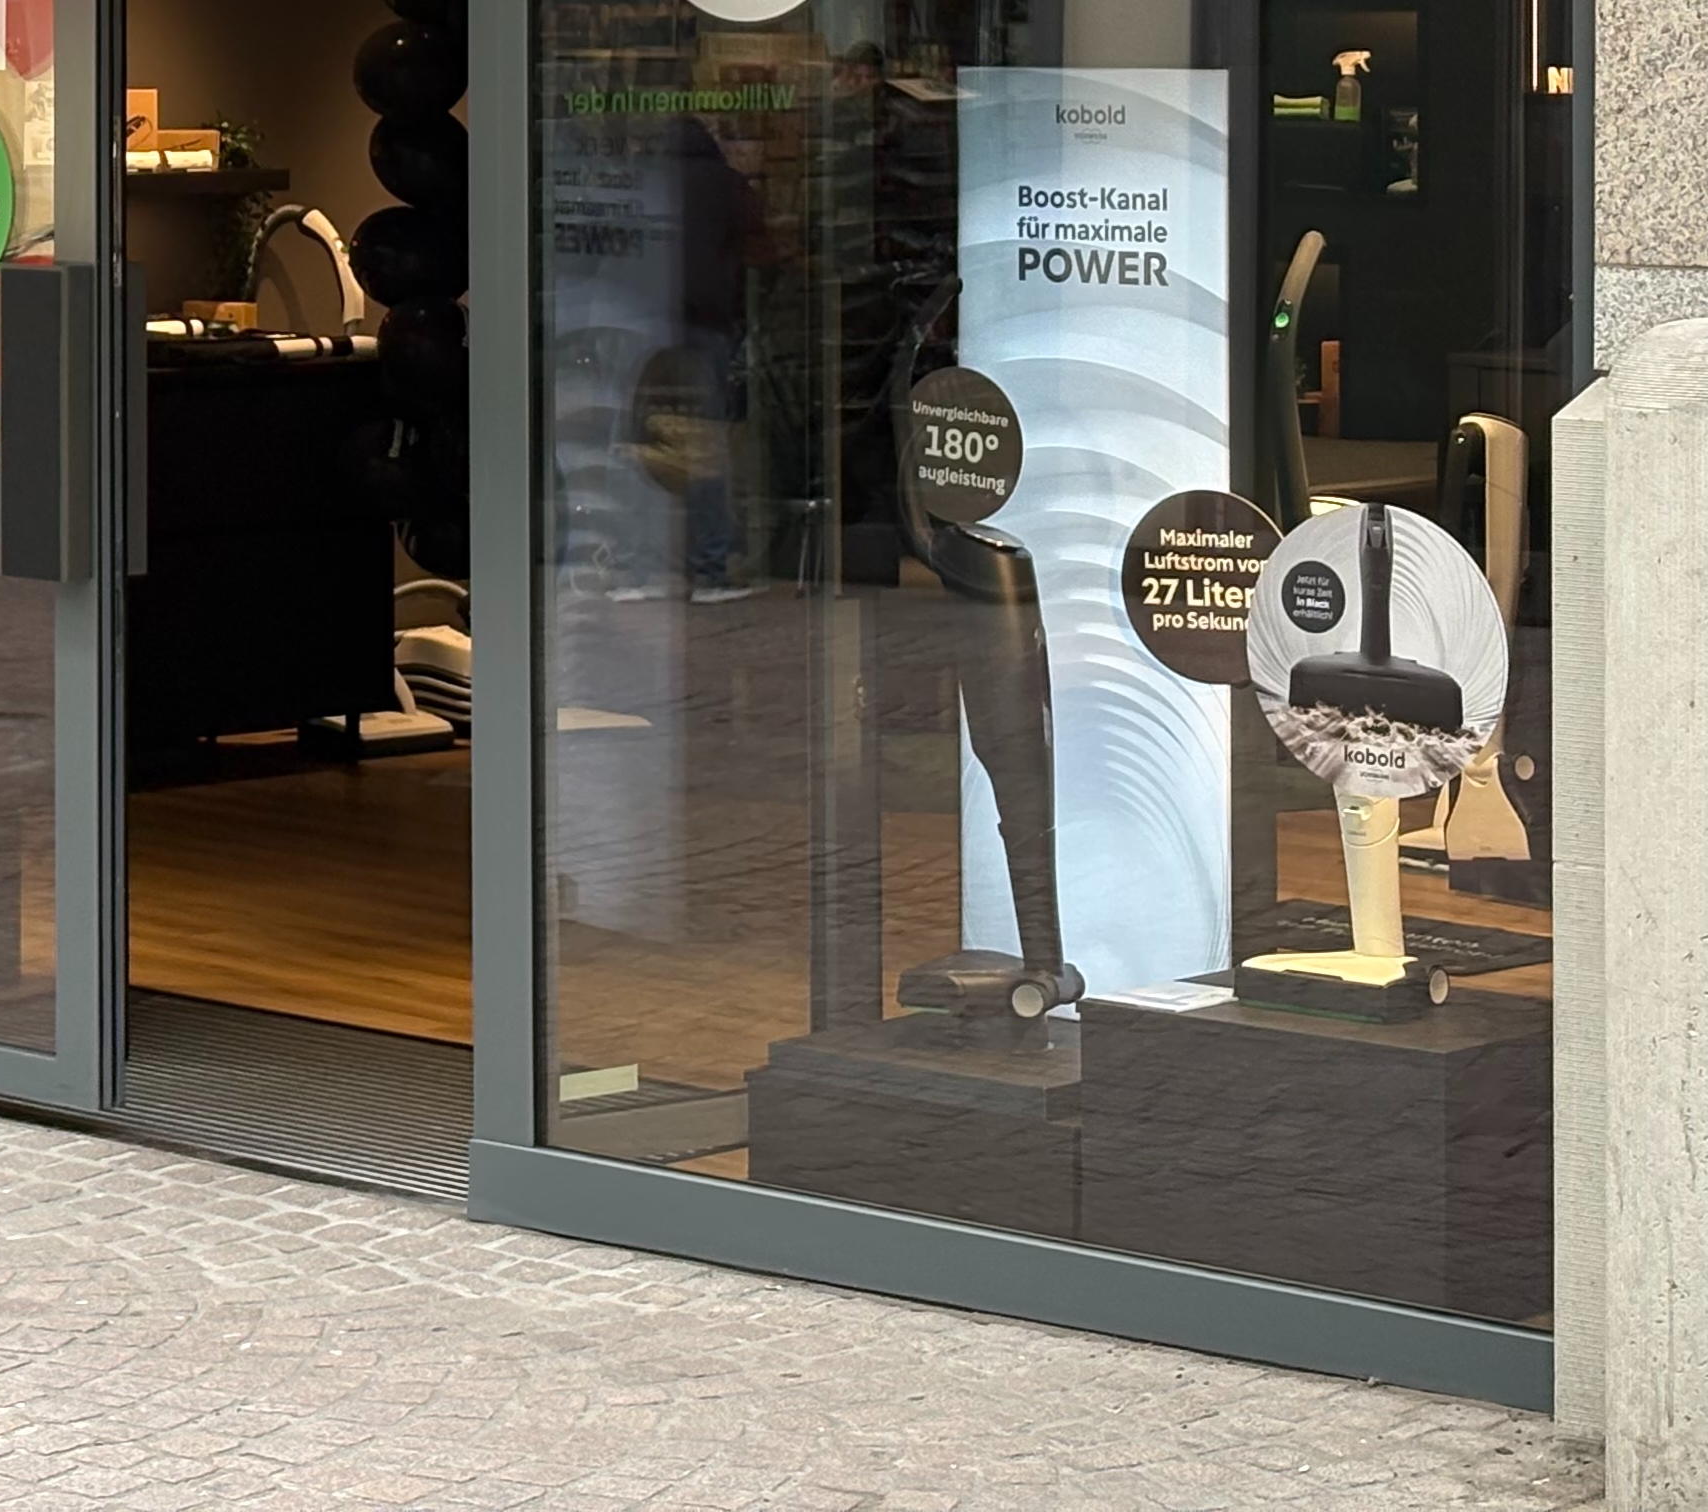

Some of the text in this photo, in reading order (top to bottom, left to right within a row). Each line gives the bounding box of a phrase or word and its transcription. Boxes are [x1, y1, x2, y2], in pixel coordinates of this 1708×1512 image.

[1055, 104, 1126, 125] kobold
[1018, 186, 1168, 211] Boost-Kanal
[1017, 216, 1168, 243] für maximale
[1018, 247, 1169, 287] POWER
[913, 400, 1009, 428] Unvergleichbare
[924, 425, 999, 464] 180°
[1159, 528, 1253, 548] Maximaler
[1144, 551, 1234, 572] Luftstrom
[1141, 577, 1255, 608] 27 Liter
[1153, 613, 1184, 631] pro
[1344, 744, 1406, 769] kobold
